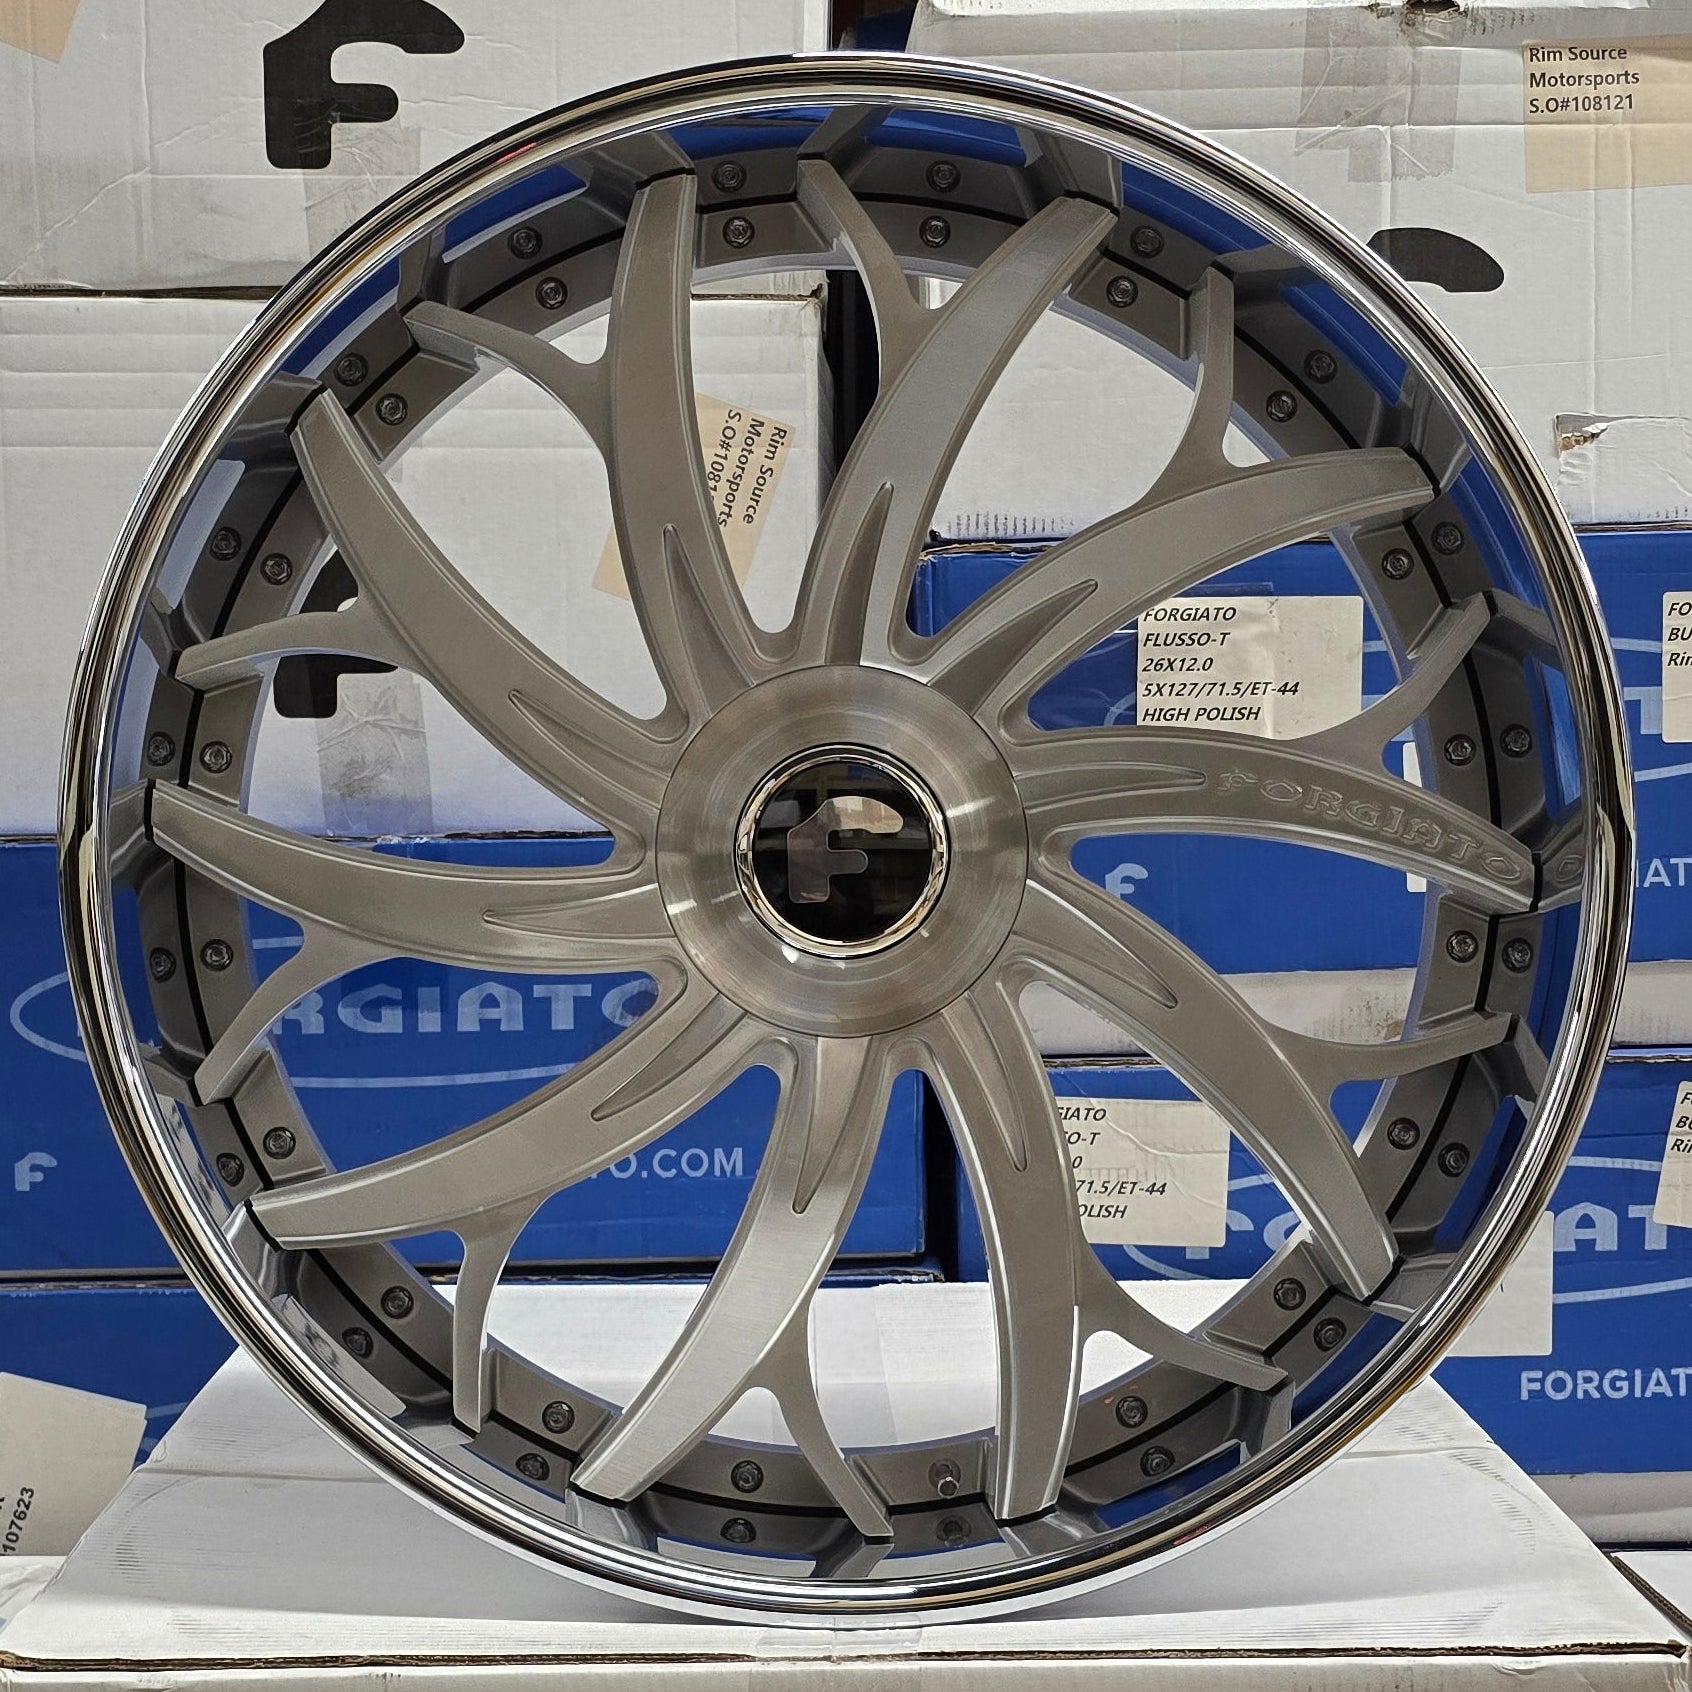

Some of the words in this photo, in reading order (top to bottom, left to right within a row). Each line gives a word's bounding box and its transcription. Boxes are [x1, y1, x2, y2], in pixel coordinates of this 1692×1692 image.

[1529, 47, 1562, 62] Rim
[1568, 46, 1627, 60] Source
[1529, 70, 1640, 90] Motorsports
[1529, 94, 1633, 113] S.O#108121
[764, 426, 787, 461] Rim
[718, 418, 764, 527] Motorsports
[743, 464, 773, 524] Source
[1144, 607, 1236, 622] FORGIATO
[1143, 632, 1230, 647] FLUSSO-T
[1142, 658, 1213, 672] 26X12.0
[1142, 681, 1300, 698] 5X127/71.5/ET-44
[1142, 708, 1190, 722] HIGH
[1195, 706, 1261, 721] POLISH
[1215, 768, 1522, 880] FORGIATO
[1079, 1204, 1128, 1218] OLISH
